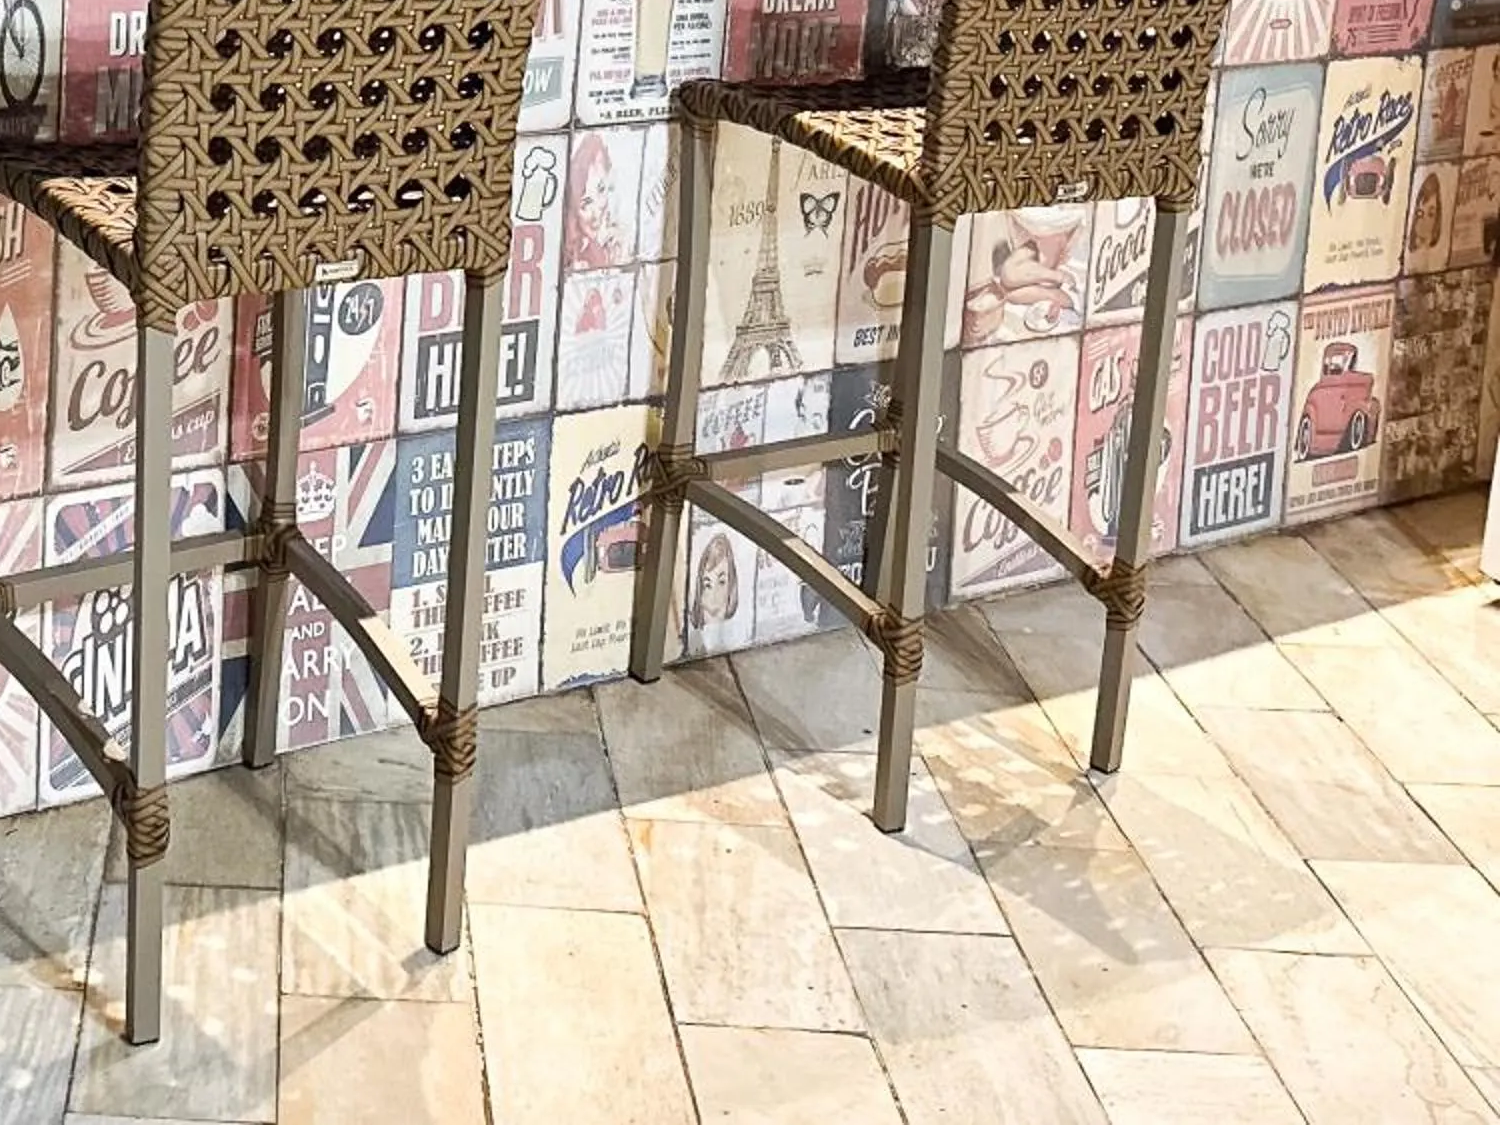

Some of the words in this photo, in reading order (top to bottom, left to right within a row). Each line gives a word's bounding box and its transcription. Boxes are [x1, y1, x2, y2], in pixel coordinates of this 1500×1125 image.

[1216, 182, 1296, 260] CLOSED
[1202, 321, 1261, 384] COLD
[1196, 375, 1280, 464] BEER
[411, 456, 424, 483] 3
[491, 438, 535, 470] TEPS
[410, 488, 434, 515] TO
[560, 467, 624, 536] Retro
[1198, 463, 1267, 529] HERE!
[488, 503, 523, 532] OUR
[290, 621, 325, 641] AND
[284, 645, 353, 682] ARRY
[491, 667, 516, 688] UP
[278, 688, 330, 727] ON
